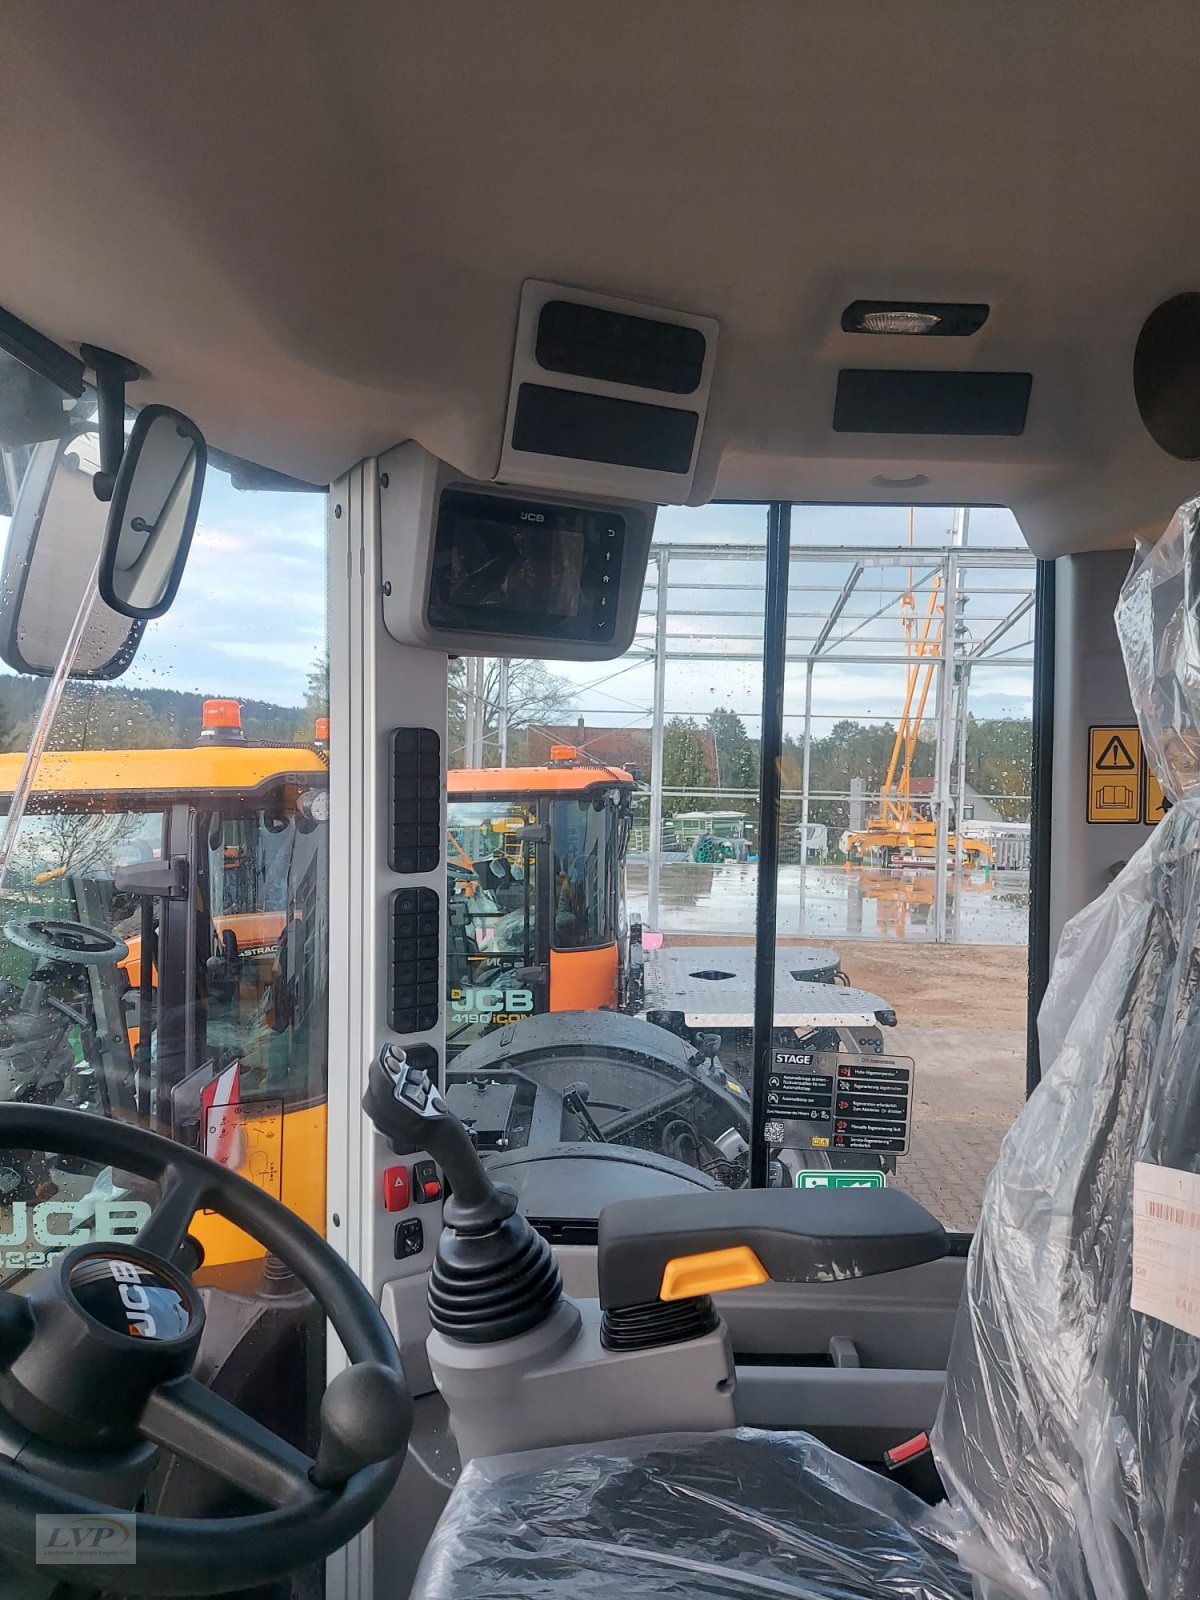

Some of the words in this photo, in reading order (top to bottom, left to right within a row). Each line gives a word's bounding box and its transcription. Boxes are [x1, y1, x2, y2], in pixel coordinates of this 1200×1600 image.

[520, 512, 545, 522] JCB
[452, 989, 534, 1012] JCB
[451, 1014, 491, 1024] 4190
[776, 1054, 811, 1065] STAGE
[0, 1201, 152, 1246] JCB
[108, 1259, 158, 1338] JCB
